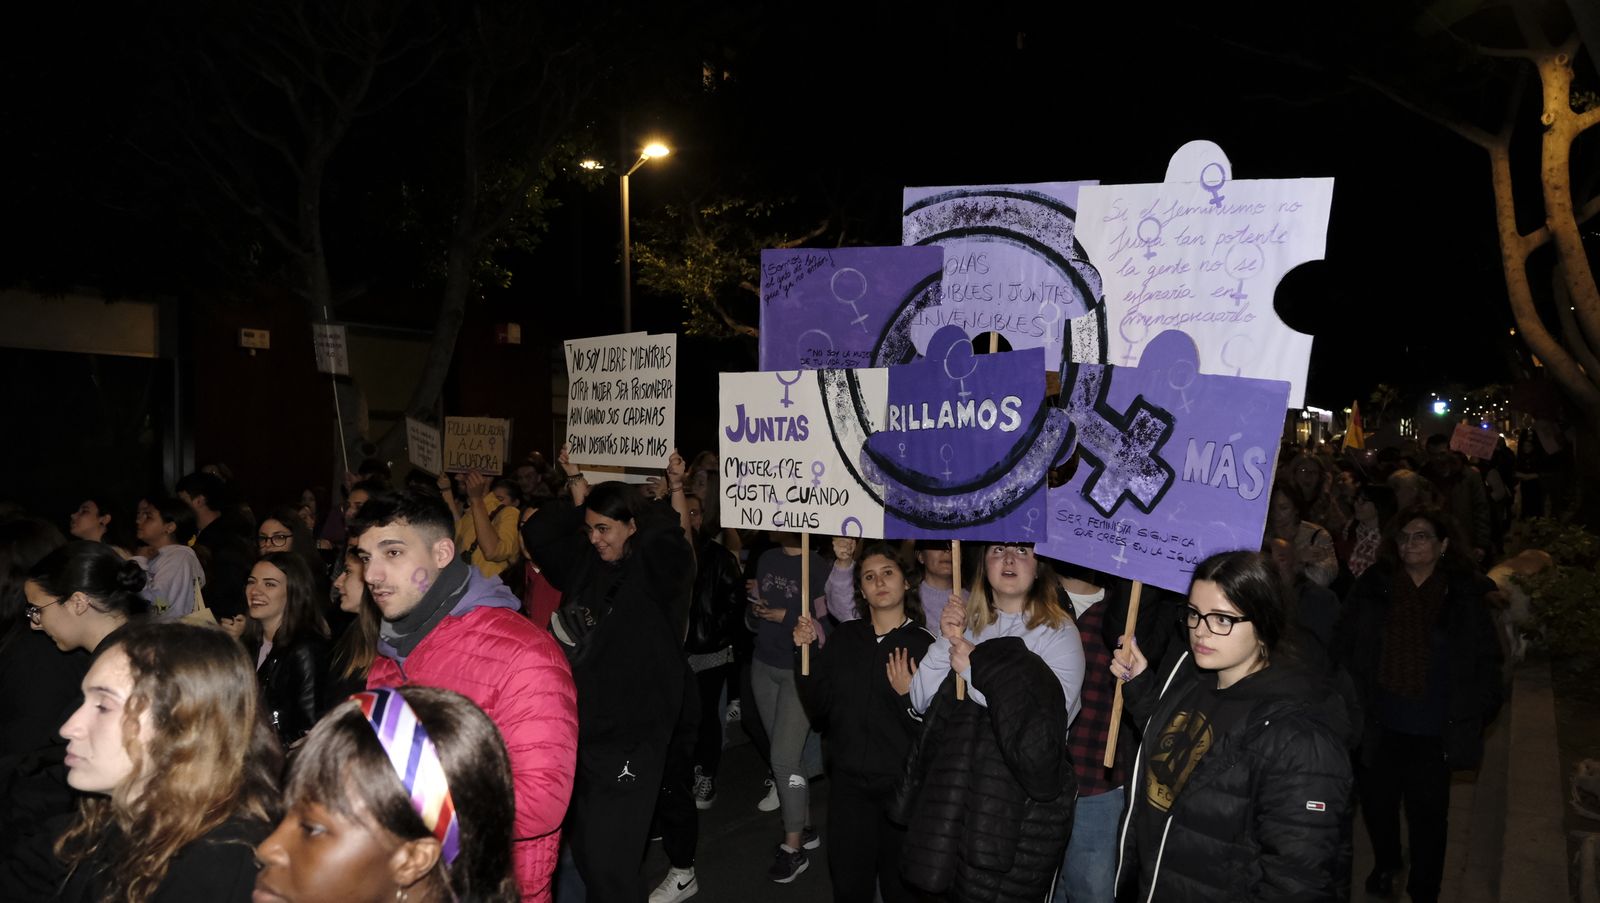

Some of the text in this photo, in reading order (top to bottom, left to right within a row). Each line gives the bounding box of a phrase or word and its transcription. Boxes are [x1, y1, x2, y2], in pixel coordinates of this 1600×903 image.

[1160, 200, 1265, 228] feminismo
[1278, 201, 1302, 213] no
[1174, 226, 1206, 246] tan
[1212, 223, 1288, 256] potente
[944, 252, 990, 276] OLAS
[1116, 257, 1257, 287] la gente no se
[1007, 281, 1073, 304] JUNTAS
[585, 347, 601, 374] SOY
[601, 346, 627, 372] LIBRE
[629, 344, 672, 371] MIENTRAS
[570, 377, 673, 402] OTRA MUJER SEA PRISIONERA
[583, 406, 605, 425] CUANDO
[606, 407, 620, 425] SUS
[623, 406, 666, 427] CADENAS
[725, 403, 809, 443] JUNTAS
[889, 395, 1022, 432] RILLAMOS
[458, 438, 482, 450] A LA
[568, 433, 668, 457] SEAN DISTINTAS DE LAS MIAS
[448, 450, 498, 470] LICUADORA
[724, 457, 803, 479] MUJER, ME
[1182, 432, 1267, 500] MÁS
[725, 483, 849, 506] GUSTA CUANDO
[741, 508, 820, 528] NO CALLAS
[1055, 510, 1082, 525] SER
[1087, 517, 1132, 535] FEMINISTA
[1073, 528, 1094, 538] QUE
[1097, 532, 1127, 547] CREES
[1132, 542, 1148, 554] EN
[1150, 548, 1163, 556] LA
